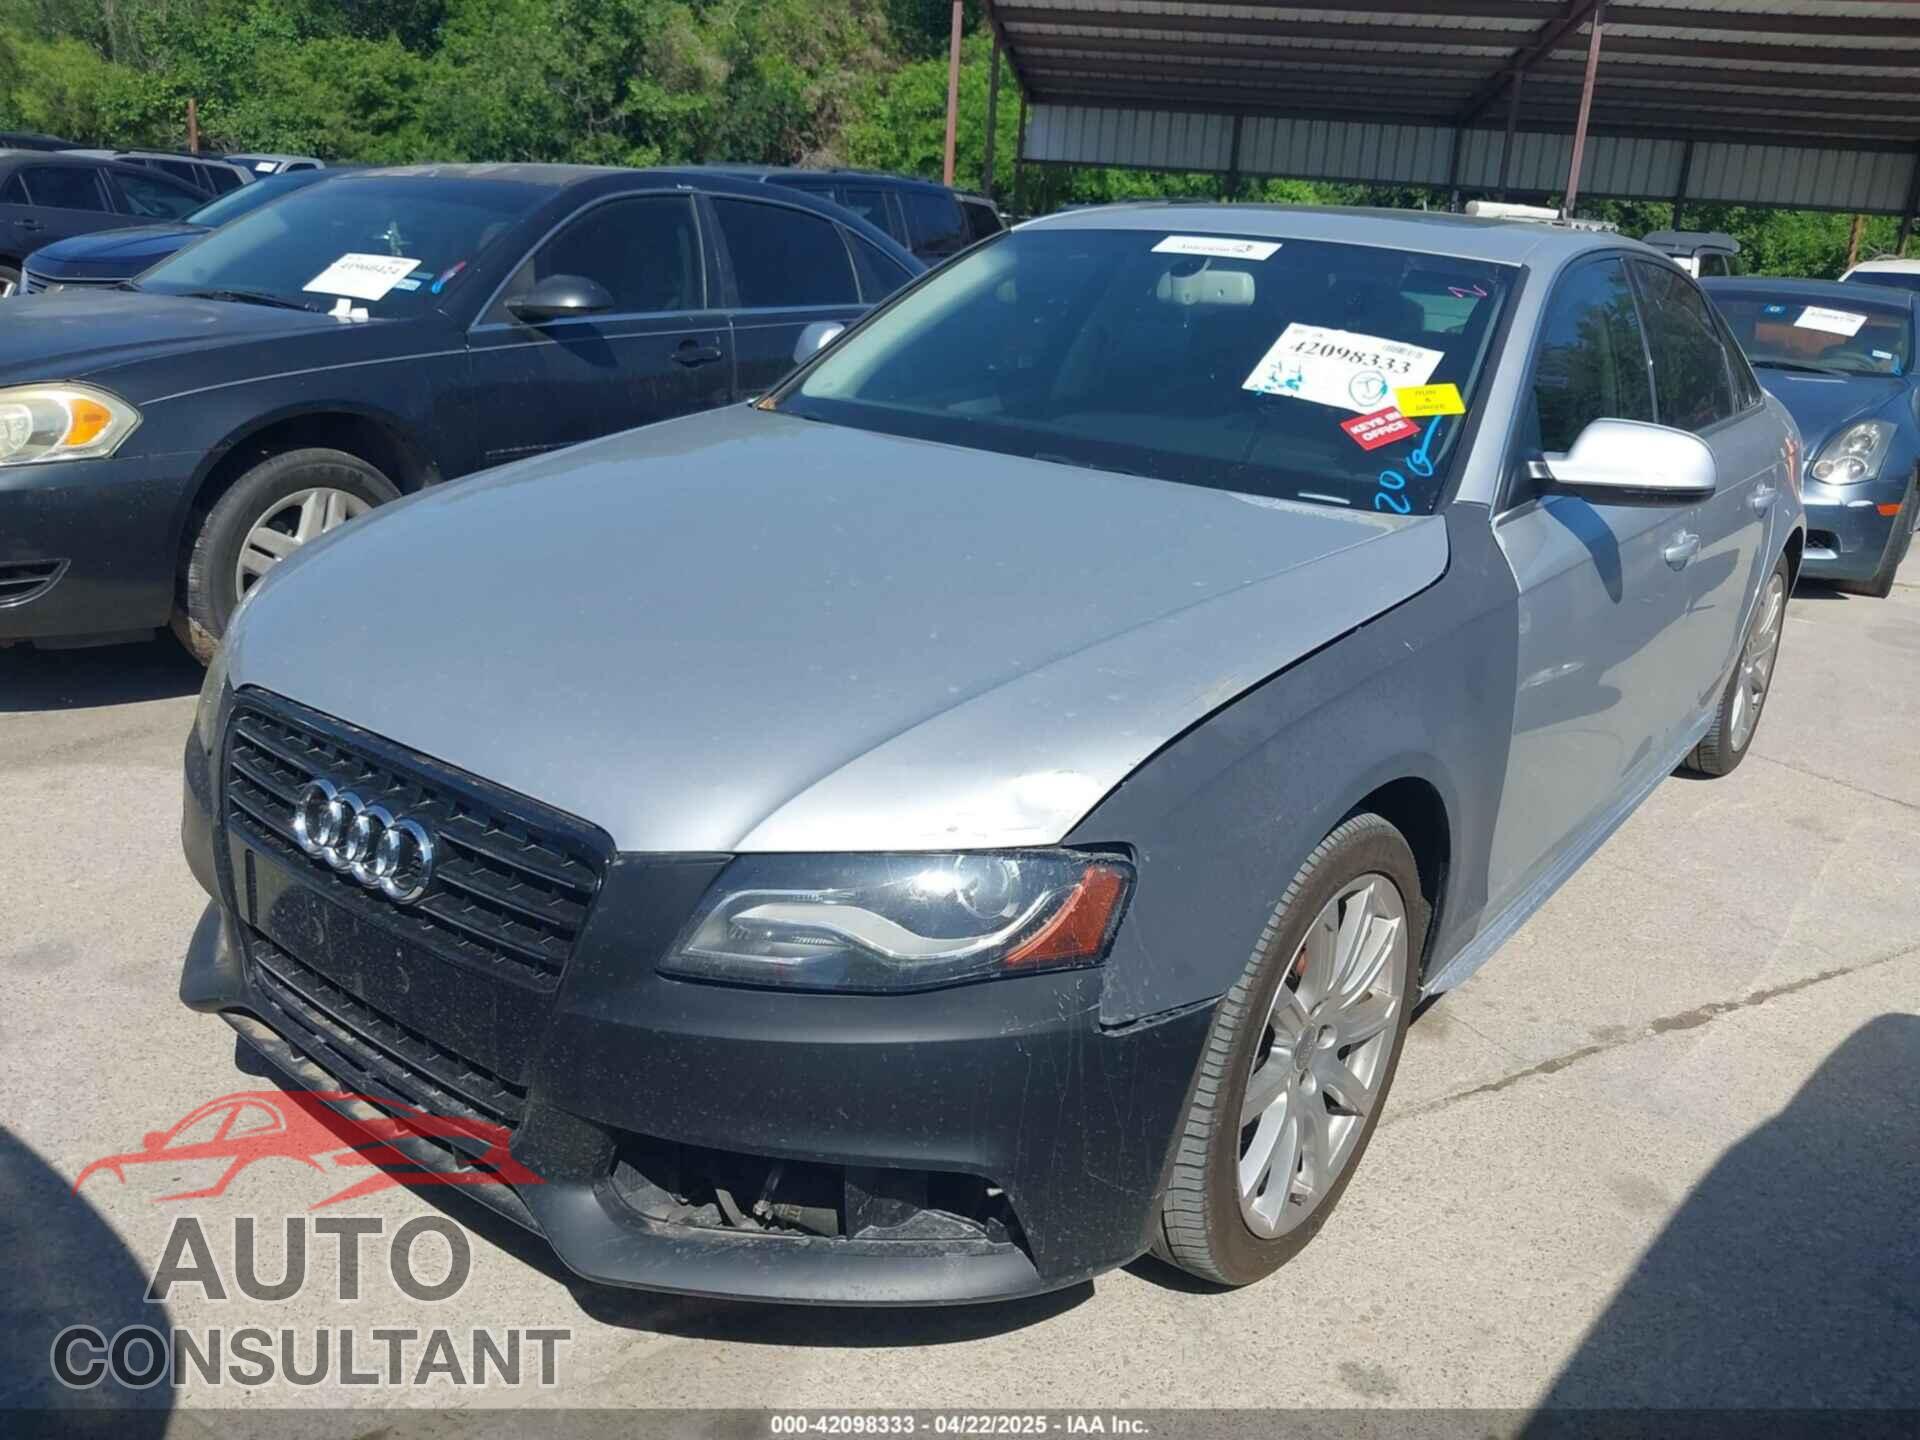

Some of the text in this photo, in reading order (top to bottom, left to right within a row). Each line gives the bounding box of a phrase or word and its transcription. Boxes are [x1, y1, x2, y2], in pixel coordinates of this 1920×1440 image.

[1289, 341, 1412, 373] 42098333
[1350, 416, 1386, 434] KEYS
[1361, 420, 1408, 441] OFFICE
